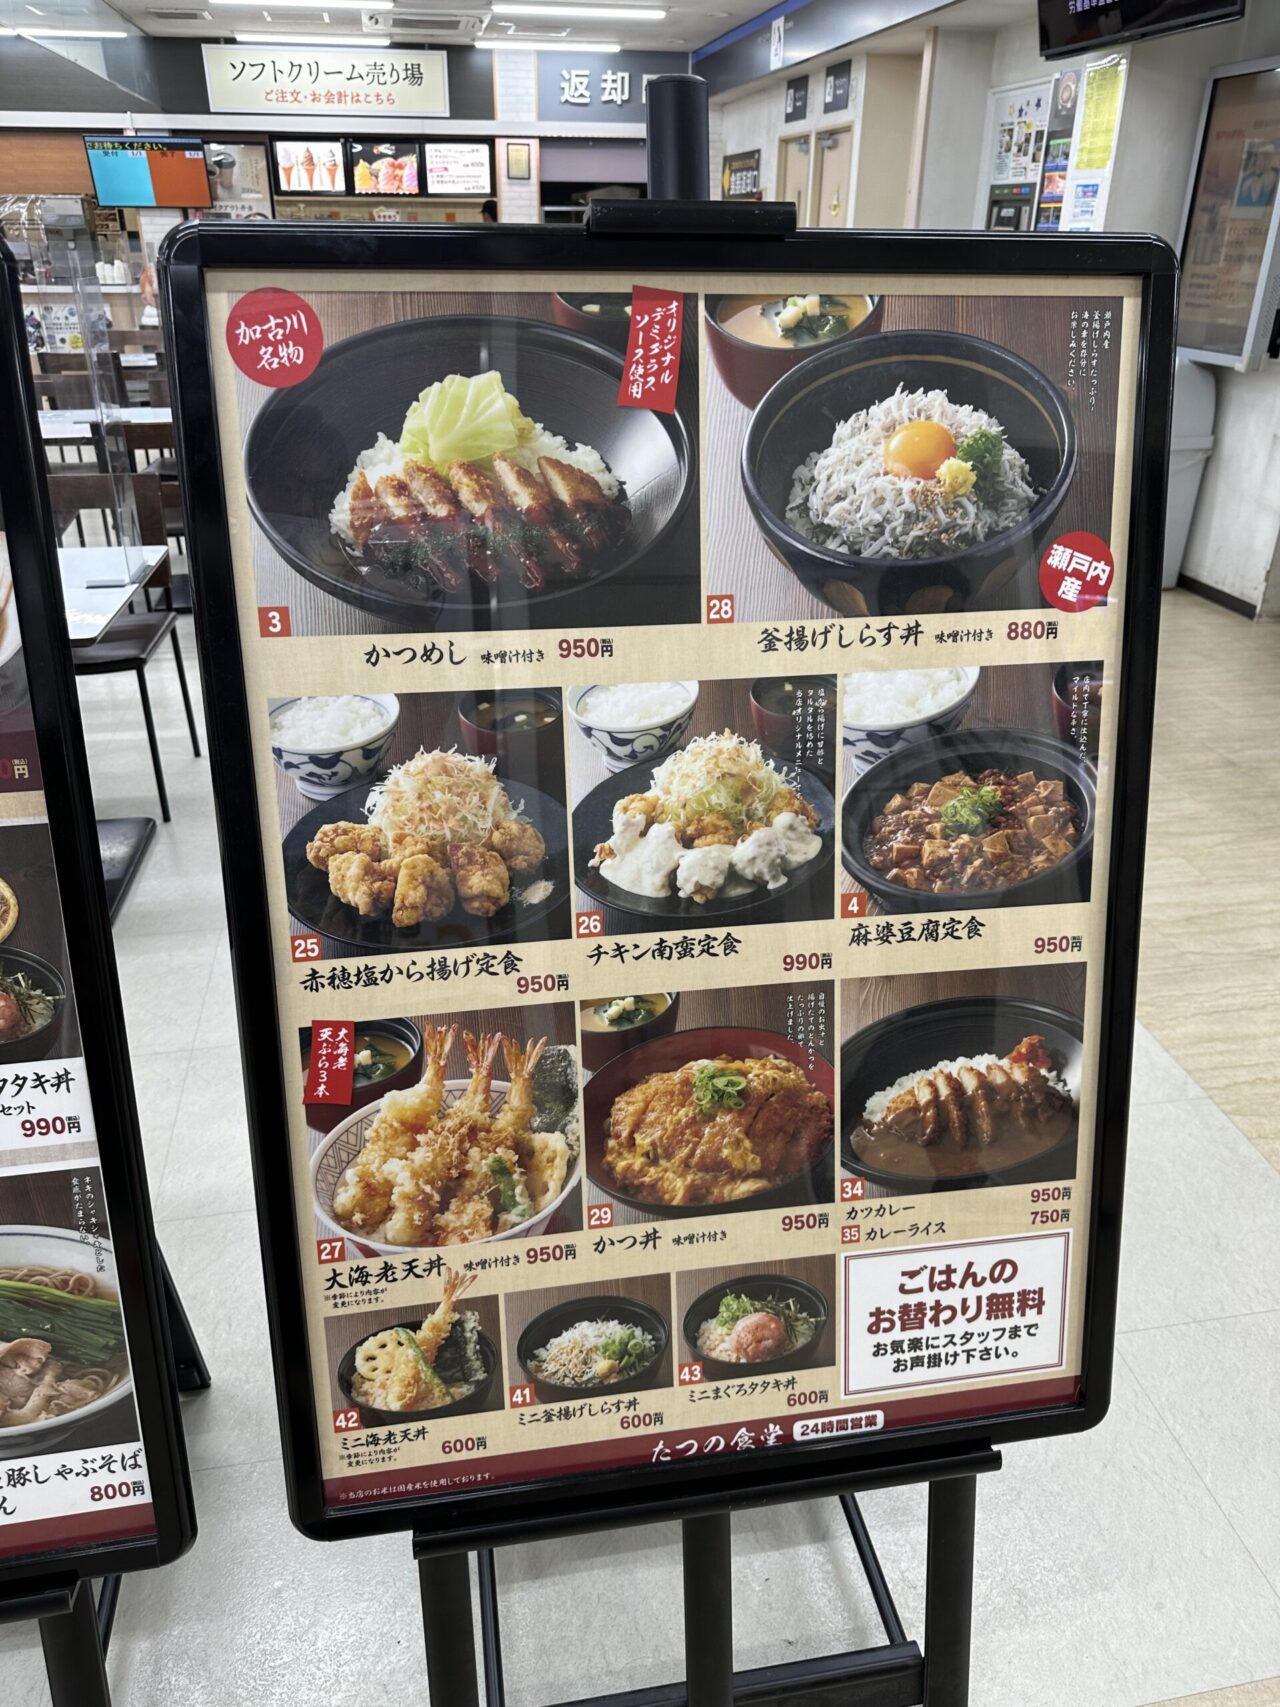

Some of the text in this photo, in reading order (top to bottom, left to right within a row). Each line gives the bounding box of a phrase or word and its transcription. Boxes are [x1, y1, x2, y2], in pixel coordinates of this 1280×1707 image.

[229, 60, 424, 87] ソフトクリーム売り場
[560, 69, 666, 105] 返却
[264, 89, 396, 106] ご注文・お会計はこちら
[235, 310, 308, 346] 加古川
[660, 300, 679, 385] オリジナル
[1101, 310, 1112, 349] 瀬戸内産
[257, 342, 304, 371] 名物
[628, 314, 650, 400] ソース使用
[644, 307, 667, 392] デミグラス
[1067, 310, 1078, 391] お楽しみください。
[1079, 310, 1090, 377] 海の幸を存分に
[1046, 543, 1111, 586] 瀬戸内
[1057, 575, 1083, 603] 産
[268, 611, 282, 633] 3
[708, 599, 733, 620] 28
[757, 619, 925, 653] 釜揚げしらす丼
[934, 628, 994, 644] 味噌汁付き
[1006, 620, 1059, 641] 880円
[363, 640, 468, 667] かつめし
[480, 648, 545, 665] 味噌汁付き
[558, 637, 614, 659] 950円
[847, 896, 859, 914] 4
[578, 915, 601, 934] 26
[848, 915, 986, 947] 麻婆豆腐定食
[294, 939, 319, 957] 25
[586, 931, 742, 967] チキン南蛮定食
[1034, 935, 1082, 954] 950円
[299, 949, 523, 993] 赤穂塩から揚げ定食
[782, 952, 832, 972] 990円
[516, 974, 570, 995] 950円
[313, 1027, 333, 1098] 天ぷら3本
[332, 1027, 349, 1070] 大海老
[21, 1116, 82, 1138] 990円
[841, 1181, 864, 1199] 34
[845, 1186, 1072, 1221] カツカレー 950円
[589, 1207, 612, 1225] 29
[865, 1208, 1071, 1242] カレーライス 750円
[592, 1211, 829, 1254] かつ丼 味噌汁付き 950円
[842, 1228, 859, 1242] 35
[320, 1241, 342, 1261] 27
[324, 1254, 448, 1291] 大海老天丼
[463, 1256, 521, 1272] 味噌汁付き
[526, 1243, 577, 1265] 950円
[898, 1258, 1019, 1295] ごはんの
[866, 1287, 1046, 1335] お替わり無料
[872, 1323, 1039, 1358] お気楽にスタッフまで
[680, 1365, 701, 1382] 43
[892, 1346, 1019, 1373] お声掛け下さい。
[512, 1387, 531, 1405] 41
[688, 1375, 799, 1403] ミニまぐろタタキ丼
[787, 1389, 829, 1407] 600円
[335, 1411, 359, 1429] 42
[517, 1396, 640, 1426] ミニ釜揚げしらす丼
[620, 1412, 664, 1430] 600円
[340, 1425, 429, 1451] ミニ海老天丼
[441, 1436, 487, 1455] 600円
[652, 1414, 878, 1463] たつの食堂 24時間営業
[0, 1448, 144, 1490] 豚しゃぶそば
[90, 1481, 146, 1502] 800円
